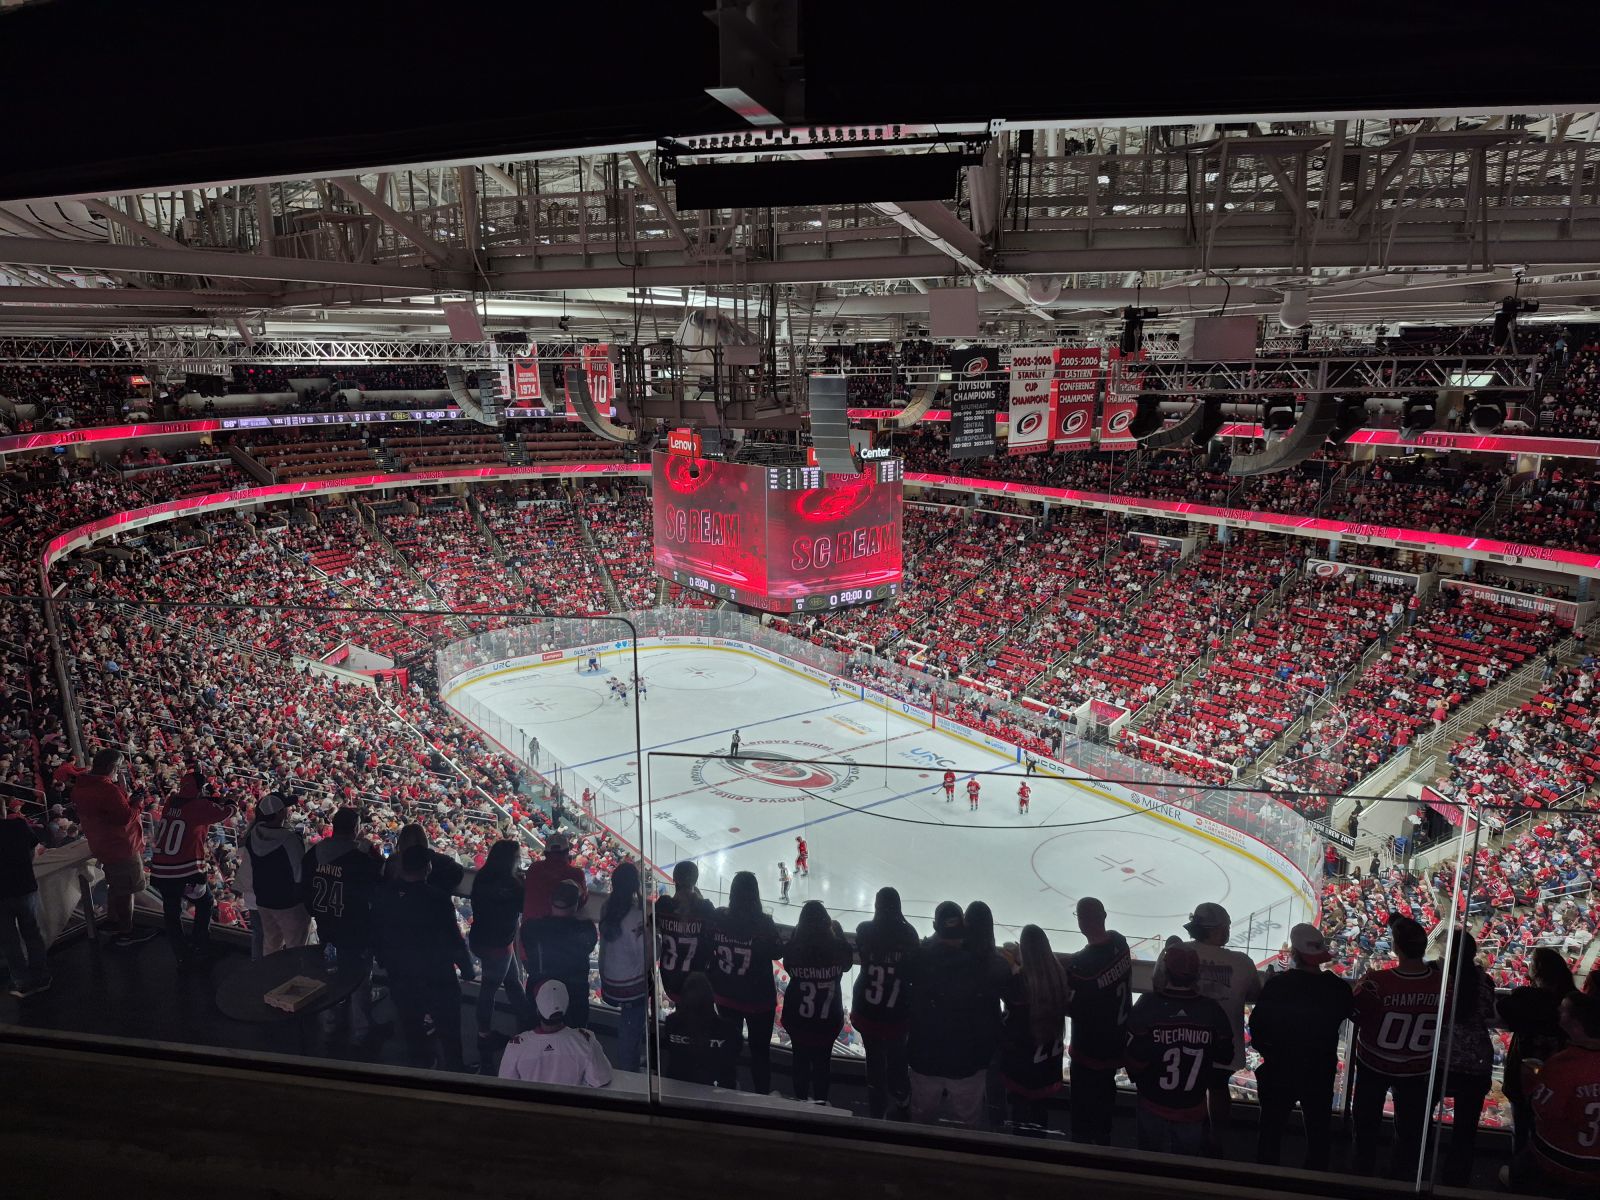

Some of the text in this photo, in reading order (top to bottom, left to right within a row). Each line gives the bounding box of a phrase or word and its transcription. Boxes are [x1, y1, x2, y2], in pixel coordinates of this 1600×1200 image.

[1013, 357, 1052, 367] 2005-2006
[1061, 357, 1099, 367] 2005-2006
[1018, 371, 1046, 379] STANLEY
[1064, 370, 1093, 379] EASTERN
[520, 384, 536, 395] 1974
[593, 374, 608, 404] 10
[958, 381, 992, 391] DIVISION
[1025, 382, 1039, 392] CUP
[1059, 381, 1096, 391] CONFERENCE
[953, 391, 996, 402] CHAMPIONS
[1012, 395, 1049, 405] CHAMPIONS
[1059, 393, 1094, 403] CHAMPIONS
[670, 436, 697, 451] Lenovo
[861, 447, 890, 459] Center
[1346, 524, 1388, 538] NOISE!
[1503, 543, 1555, 561] NOISE!
[689, 577, 715, 593] 0 20:00 0
[830, 589, 872, 606] 0 20:00 0
[1474, 590, 1517, 607] CAROLINA
[493, 660, 511, 671] UNC
[843, 682, 857, 692] PEPSI
[740, 739, 834, 752] Lenovo Center
[910, 747, 957, 769] UNC
[710, 790, 817, 804] Lenovo Center
[1142, 797, 1182, 820] MILNER
[1308, 820, 1325, 834] STORM
[1340, 834, 1355, 847] ZONE
[315, 863, 343, 879] JARVIS
[312, 876, 345, 918] 24
[661, 936, 699, 974] 37
[716, 945, 753, 977] 37
[799, 980, 837, 1021] 37
[1384, 991, 1448, 1008] CHAMPION
[1376, 1010, 1440, 1053] 06
[1159, 1045, 1205, 1093] 37
[1533, 1082, 1555, 1105] 37
